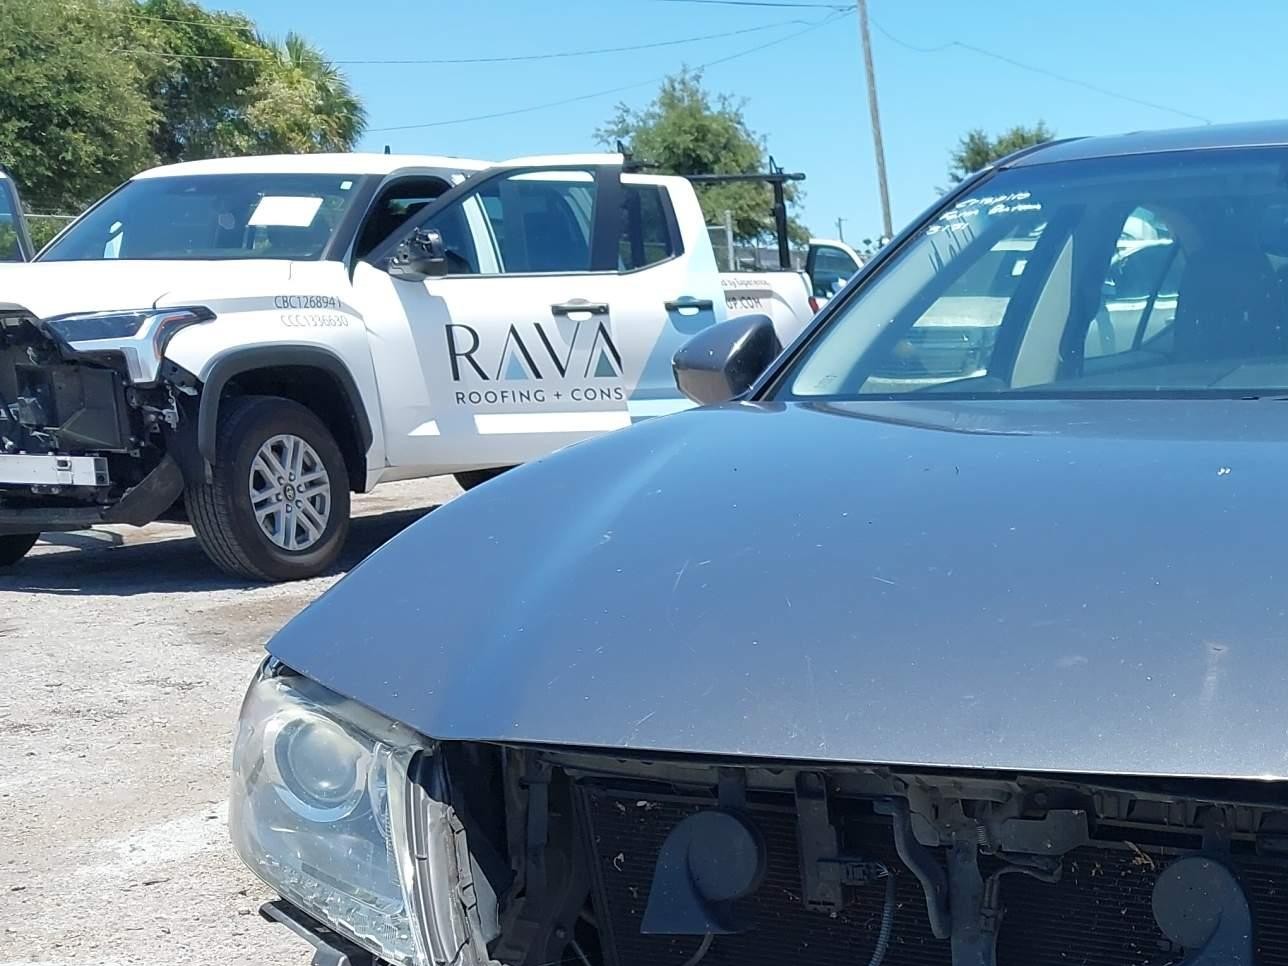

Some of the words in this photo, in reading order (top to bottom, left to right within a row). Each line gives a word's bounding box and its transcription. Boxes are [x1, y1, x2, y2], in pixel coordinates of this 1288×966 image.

[445, 320, 624, 382] RAVA
[455, 388, 545, 405] ROOFING
[571, 386, 624, 402] CONS
